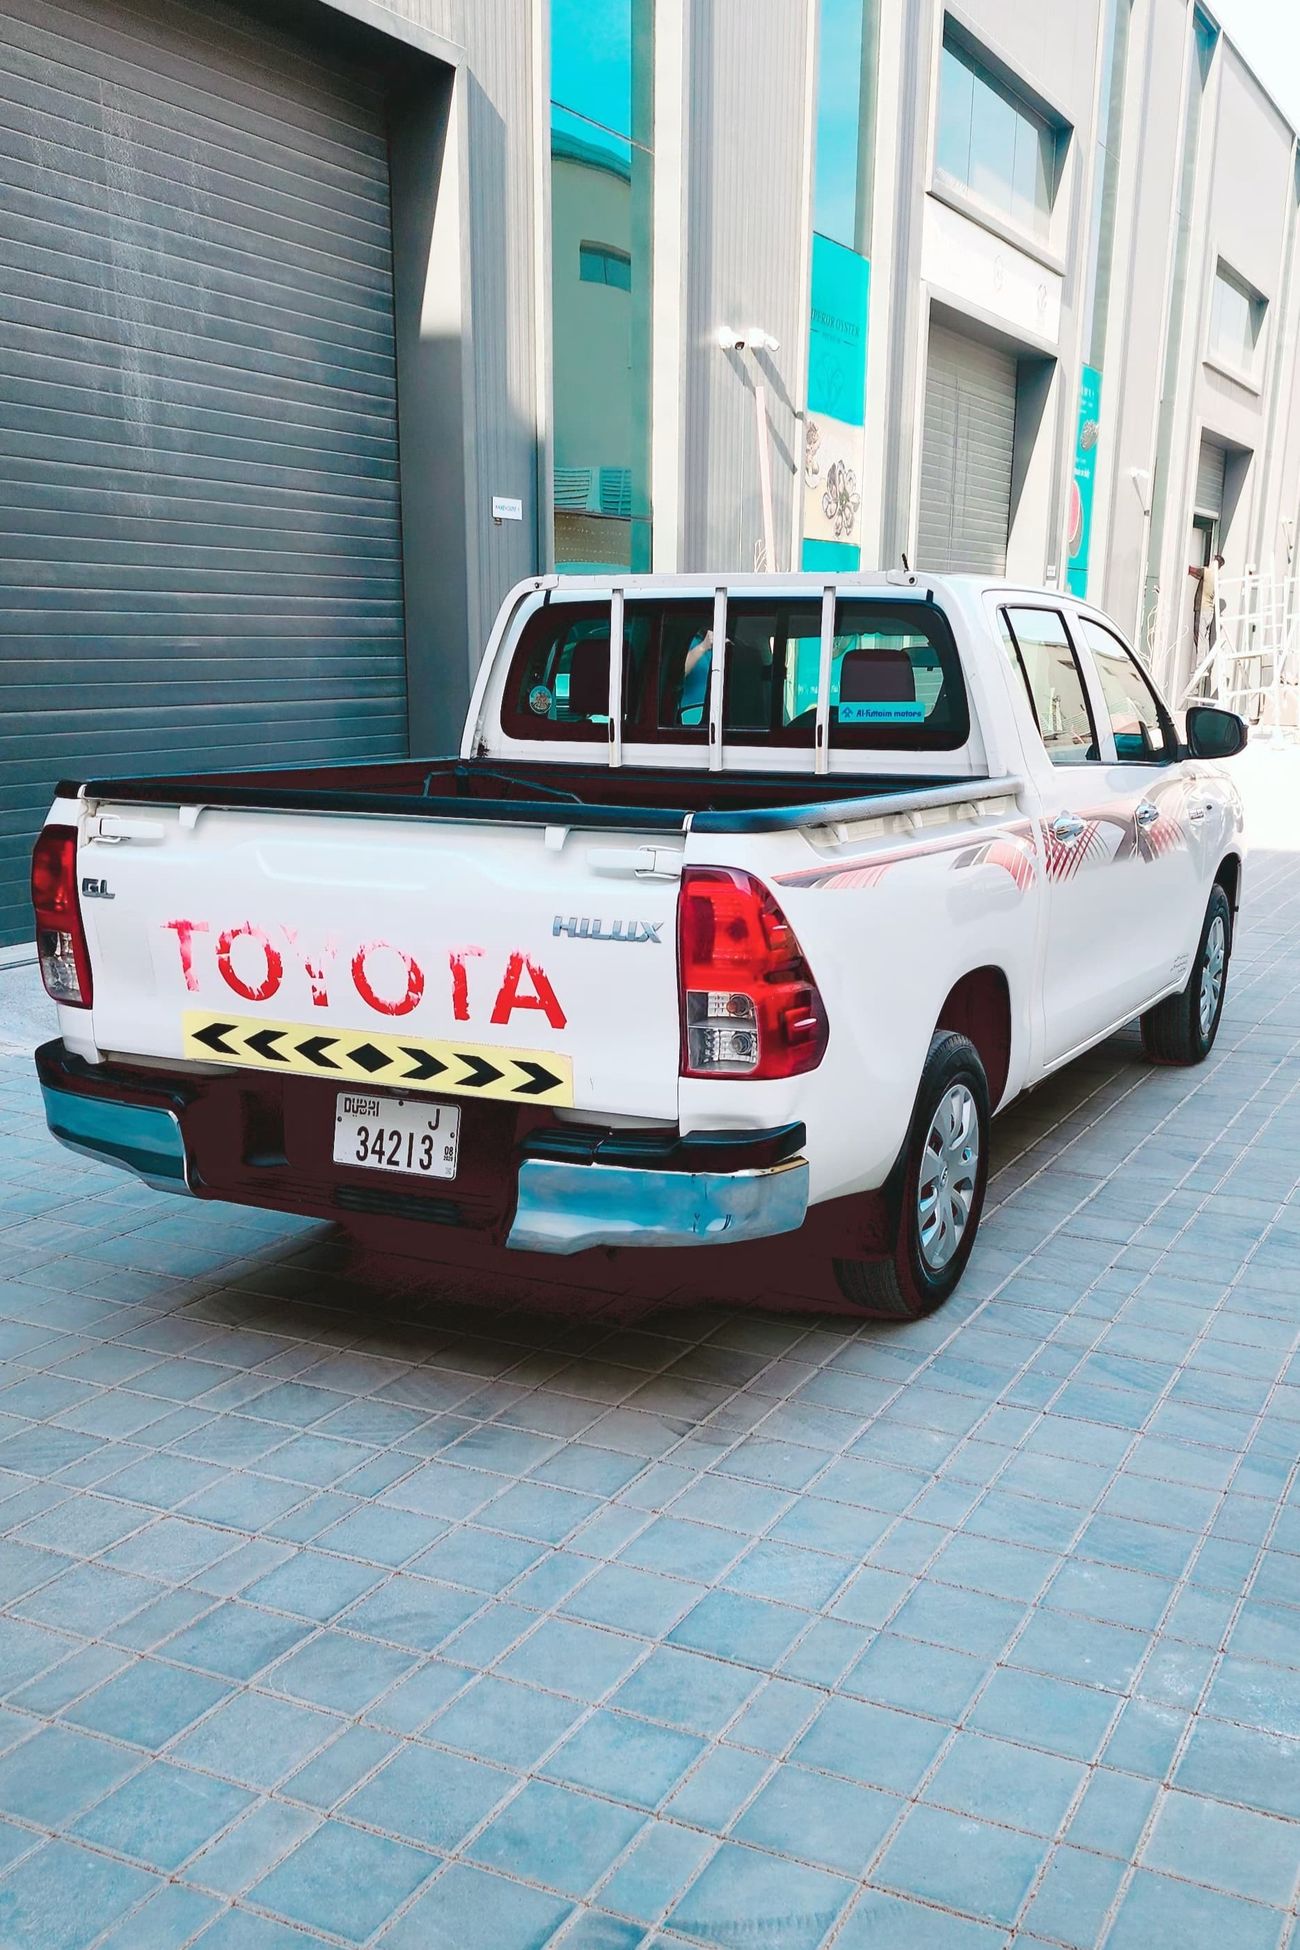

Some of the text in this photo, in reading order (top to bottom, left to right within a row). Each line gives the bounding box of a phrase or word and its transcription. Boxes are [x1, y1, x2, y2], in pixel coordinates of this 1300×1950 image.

[82, 877, 115, 899] GL
[553, 915, 664, 943] HILUX
[428, 1108, 440, 1130] J
[356, 1126, 434, 1170] 34213
[444, 1145, 454, 1157] 08
